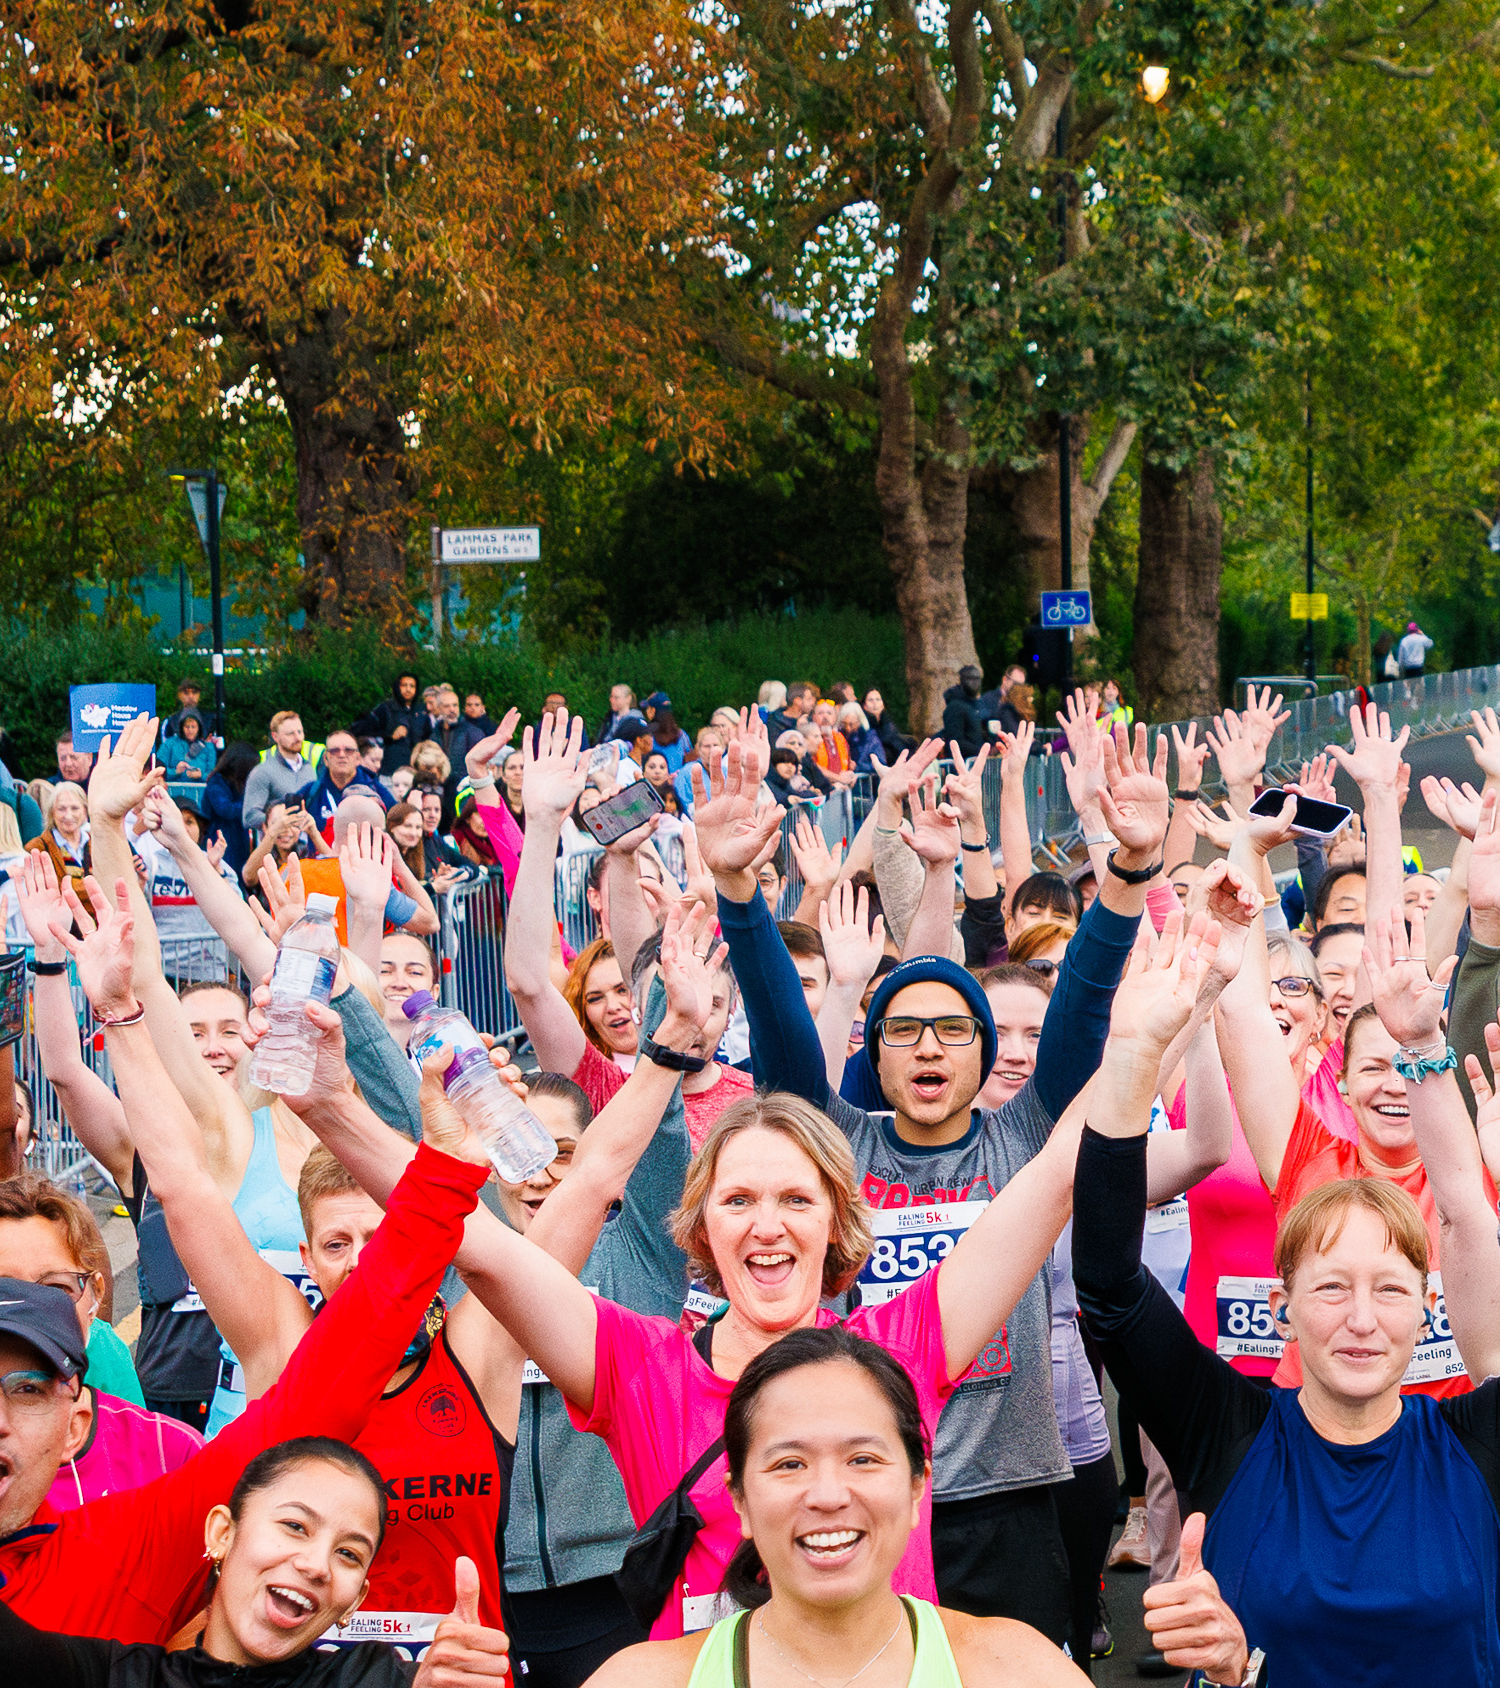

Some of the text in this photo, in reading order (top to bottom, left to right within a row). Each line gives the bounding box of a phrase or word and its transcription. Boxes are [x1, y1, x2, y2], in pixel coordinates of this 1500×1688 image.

[447, 532, 533, 545] LAMMAS PARK
[453, 545, 509, 555] GARDENS
[871, 1231, 968, 1280] 853
[407, 1503, 455, 1522] Club
[349, 1617, 382, 1626] EALING
[383, 1618, 403, 1633] 5k
[350, 1625, 383, 1634] FEELING
